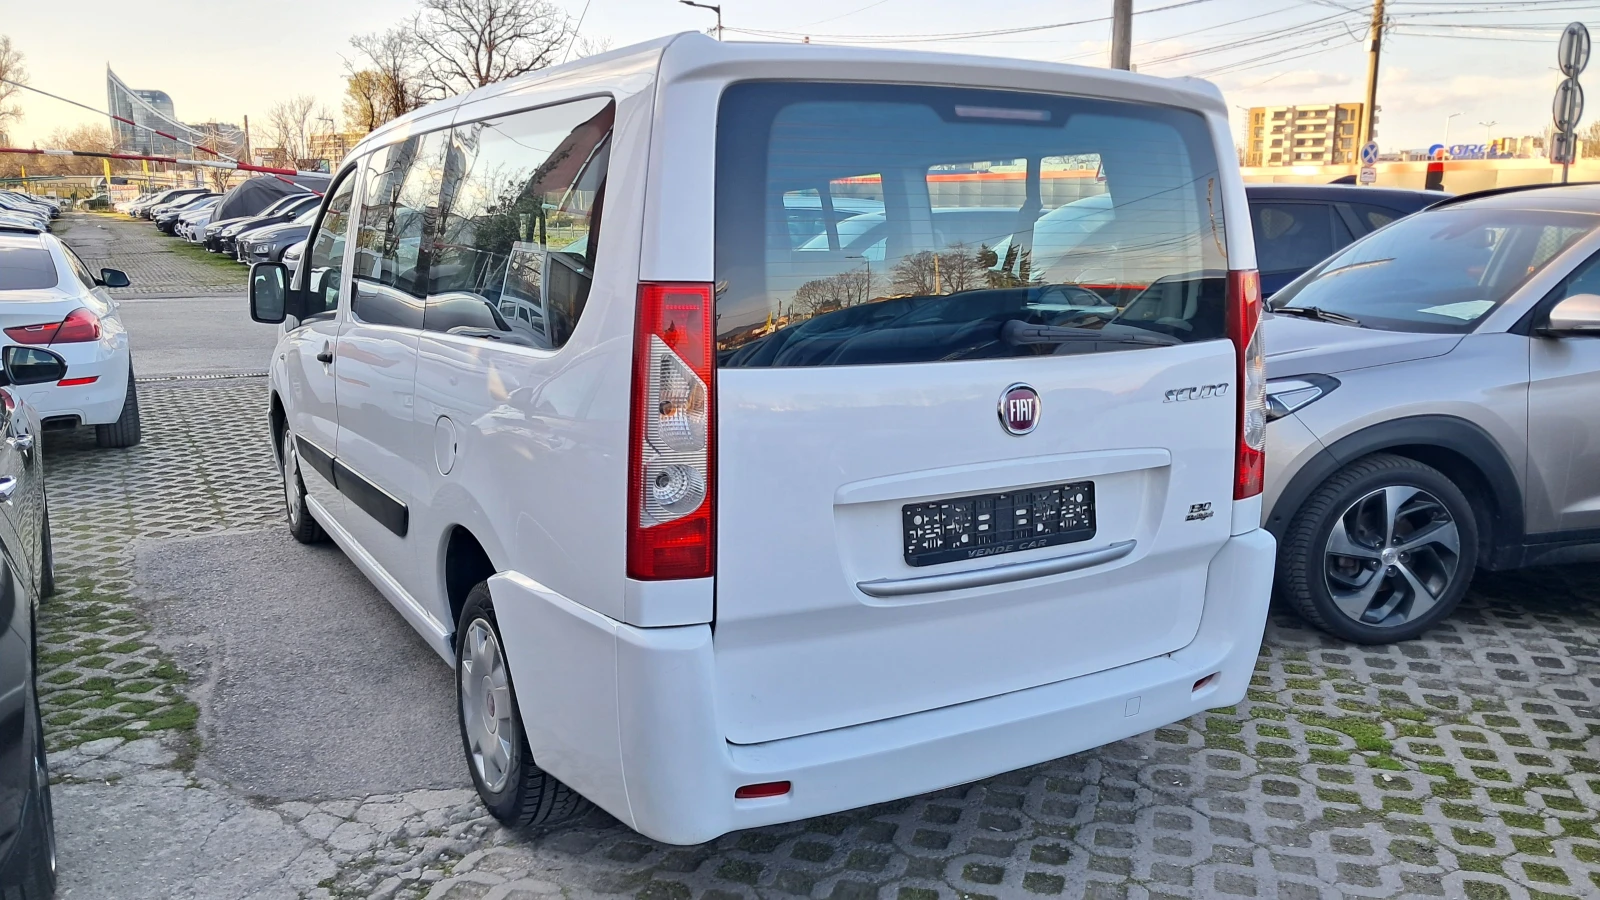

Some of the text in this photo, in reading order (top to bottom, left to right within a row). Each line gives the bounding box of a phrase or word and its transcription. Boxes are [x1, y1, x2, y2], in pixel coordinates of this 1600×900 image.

[1162, 382, 1229, 403] SCUDO
[1009, 398, 1034, 422] FIAT
[967, 538, 1047, 558] VENDE CAR
